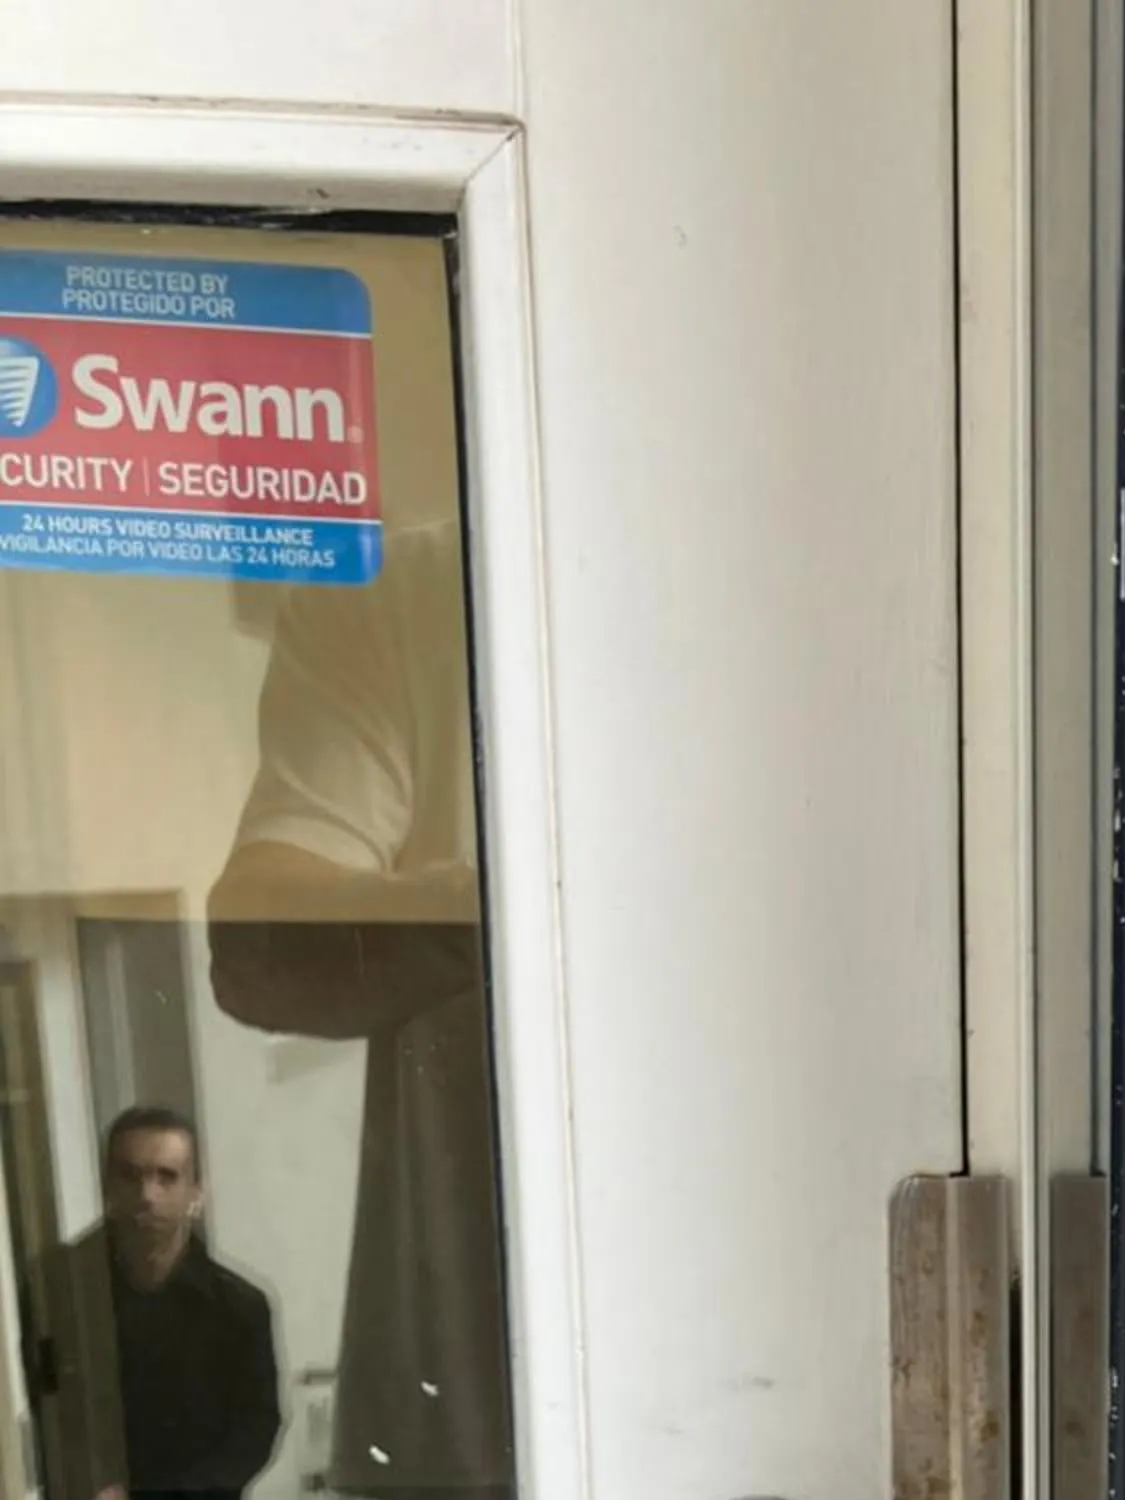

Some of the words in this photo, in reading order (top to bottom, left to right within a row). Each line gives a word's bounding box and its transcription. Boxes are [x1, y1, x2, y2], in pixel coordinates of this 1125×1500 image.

[66, 265, 196, 294] PROTECTED
[201, 273, 229, 295] BY
[61, 288, 186, 315] PROTEGIDO
[190, 295, 236, 319] POR
[71, 353, 345, 443] Swann
[158, 461, 368, 506] SEGURIDAD
[22, 513, 46, 532] 24
[47, 515, 113, 537] HOURS
[115, 518, 171, 540] VIDEO
[173, 521, 314, 546] SURVEILLANCE
[107, 538, 145, 559] POR
[147, 541, 204, 562] VIDEO
[206, 544, 243, 564] LAS
[247, 547, 266, 564] 24
[271, 548, 336, 568] HORAS
